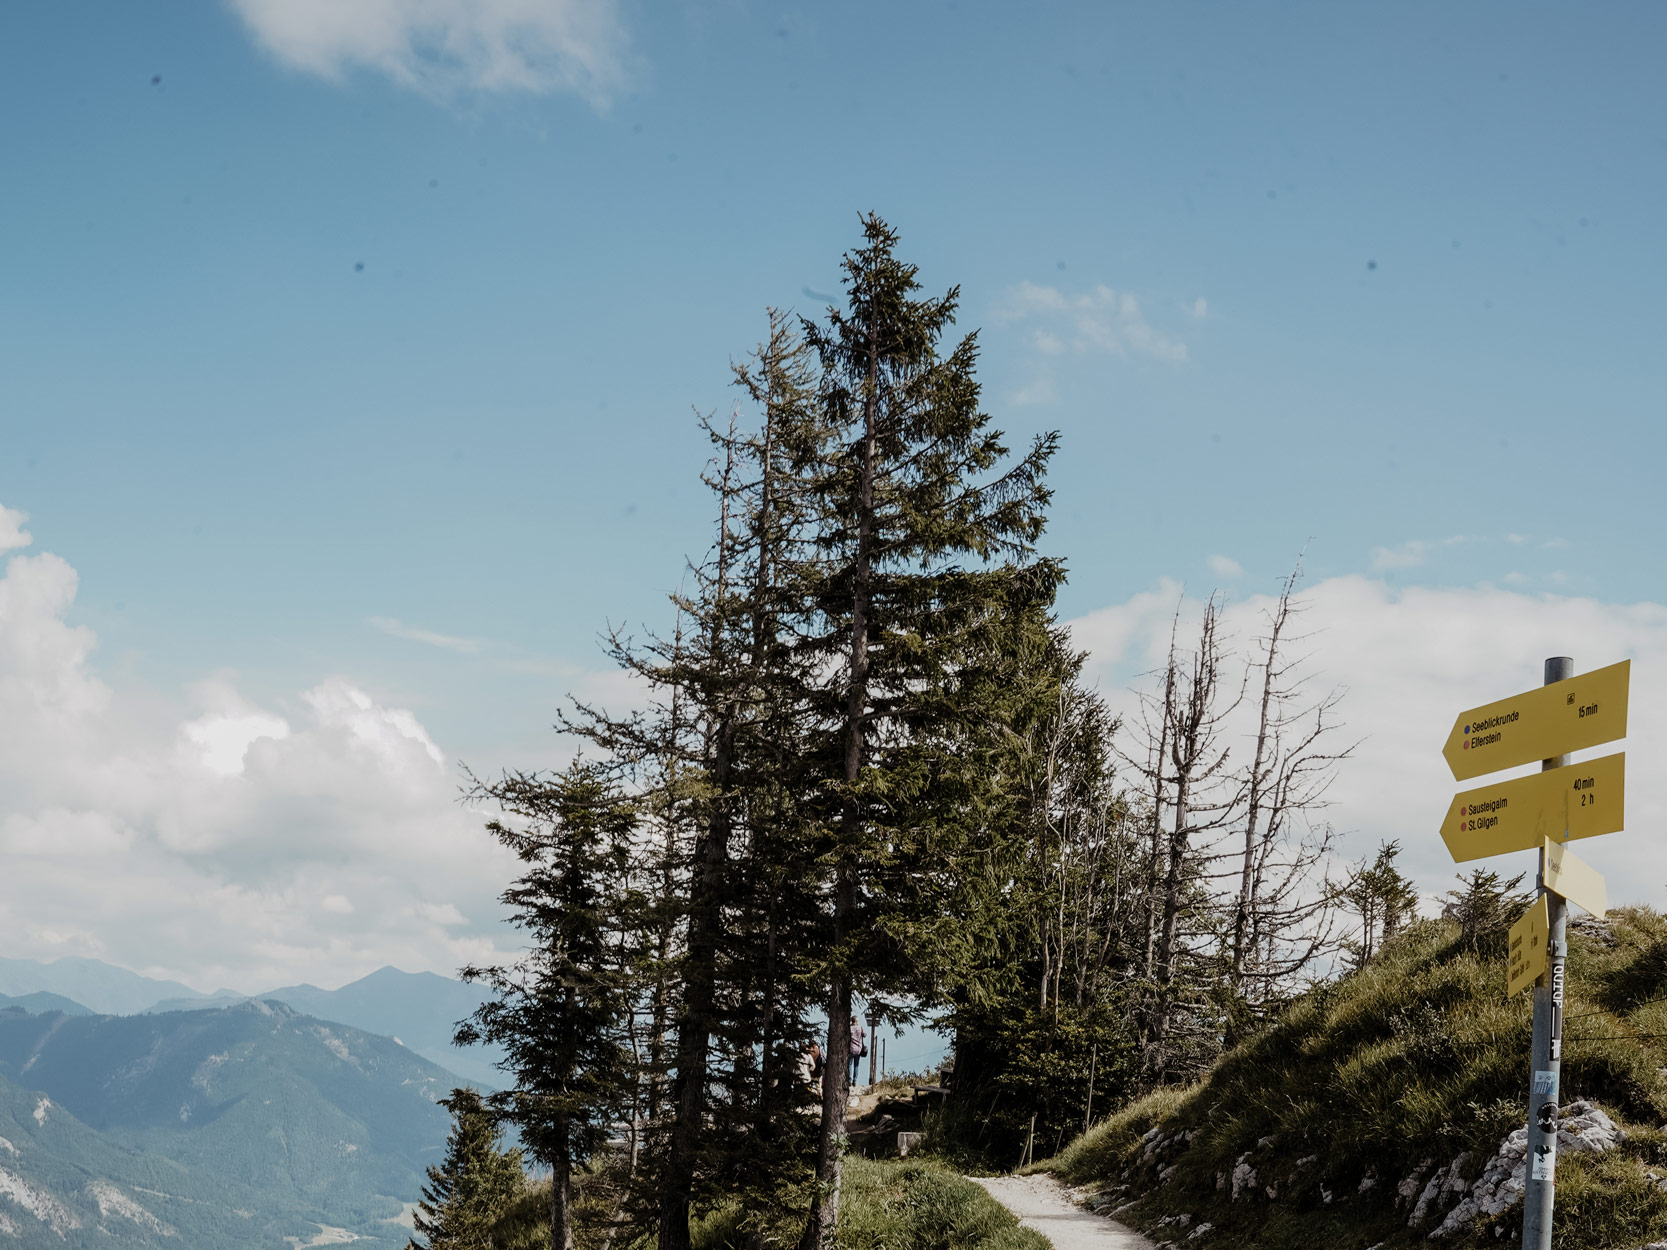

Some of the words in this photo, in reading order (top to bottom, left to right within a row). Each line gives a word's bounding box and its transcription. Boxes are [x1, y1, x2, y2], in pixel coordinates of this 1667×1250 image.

[1578, 705, 1586, 719] 15
[1585, 702, 1598, 717] min
[1471, 710, 1520, 734] Seeblickrunde
[1573, 778, 1582, 791] 40
[1581, 776, 1595, 790] min
[1468, 797, 1508, 816] Sausteigalm
[1581, 794, 1586, 807] 2
[1589, 793, 1594, 805] h
[1477, 816, 1498, 830] Gilgen
